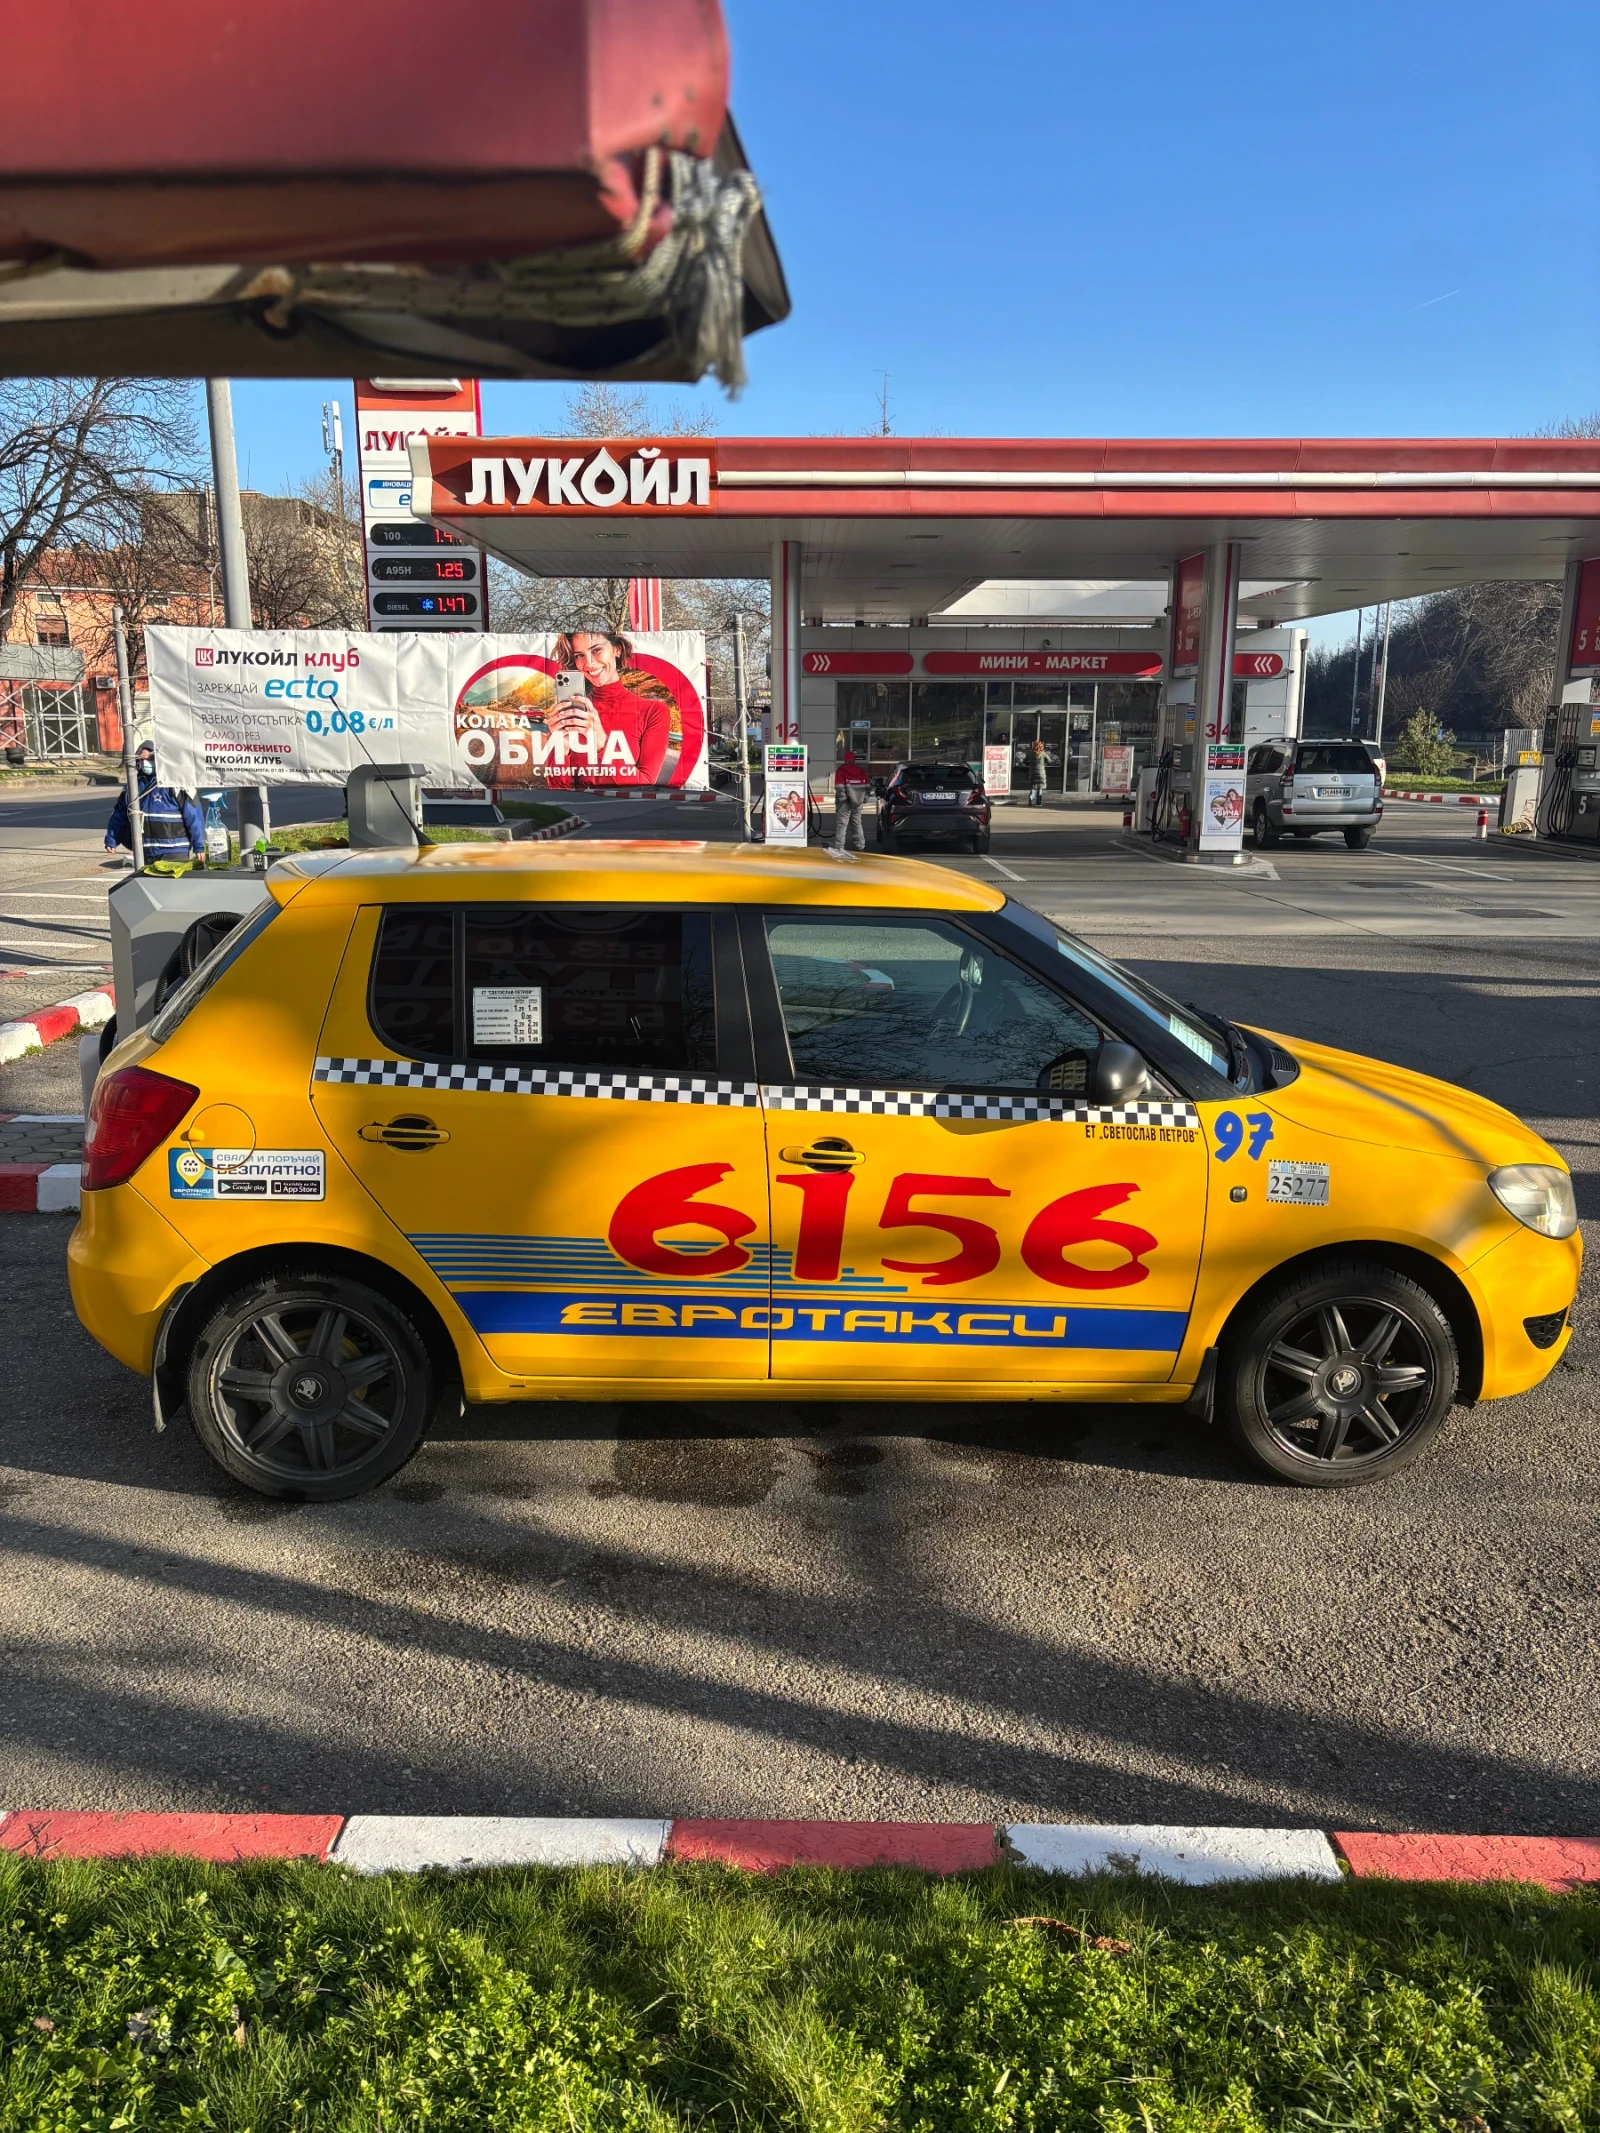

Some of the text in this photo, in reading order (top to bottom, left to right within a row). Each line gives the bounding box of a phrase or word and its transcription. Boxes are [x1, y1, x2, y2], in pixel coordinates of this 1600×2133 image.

[363, 427, 469, 451] ЛУК
[465, 447, 711, 507] ЛУКОЙЛ
[384, 532, 401, 540] 100
[436, 562, 464, 578] 1.25
[438, 598, 466, 612] 1.47
[1578, 629, 1588, 651] 5
[216, 648, 360, 672] ЛУКОЙЛ клуб
[979, 656, 1028, 669] МИНИ
[1045, 656, 1108, 669] МАРКЕТ
[197, 682, 258, 695] ЗАРЕЖДАЙ
[264, 674, 339, 699] ecto
[201, 714, 302, 726] ВЗЕМИ ОТСТЪПКА
[306, 710, 365, 736] 0,08
[456, 714, 531, 729] КОЛАТА
[204, 731, 261, 741] САМО ПРЕЗ
[776, 723, 799, 738] 1 2
[1205, 724, 1216, 738] 3
[204, 743, 292, 753] ПРИЛОЖЕНИЕТО
[458, 730, 636, 765] ОБИЧА
[205, 754, 282, 765] ЛУКОЙЛ КЛУБ
[543, 766, 616, 777] ДВИГАТЕЛЯ
[620, 767, 637, 776] СИ
[1578, 795, 1588, 815] 5
[1212, 809, 1239, 817] ОБИЧА
[1085, 1124, 1095, 1139] ЕТ
[1214, 1111, 1274, 1162] 97
[267, 1154, 320, 1163] ПОРЪЧАЙ
[217, 1163, 320, 1175] БЕЗПЛАТНО!
[254, 1184, 265, 1192] play
[1270, 1175, 1328, 1198] 25277
[607, 1162, 1159, 1291] 6156
[560, 1302, 1068, 1338] ЕВРОТАКСИ
